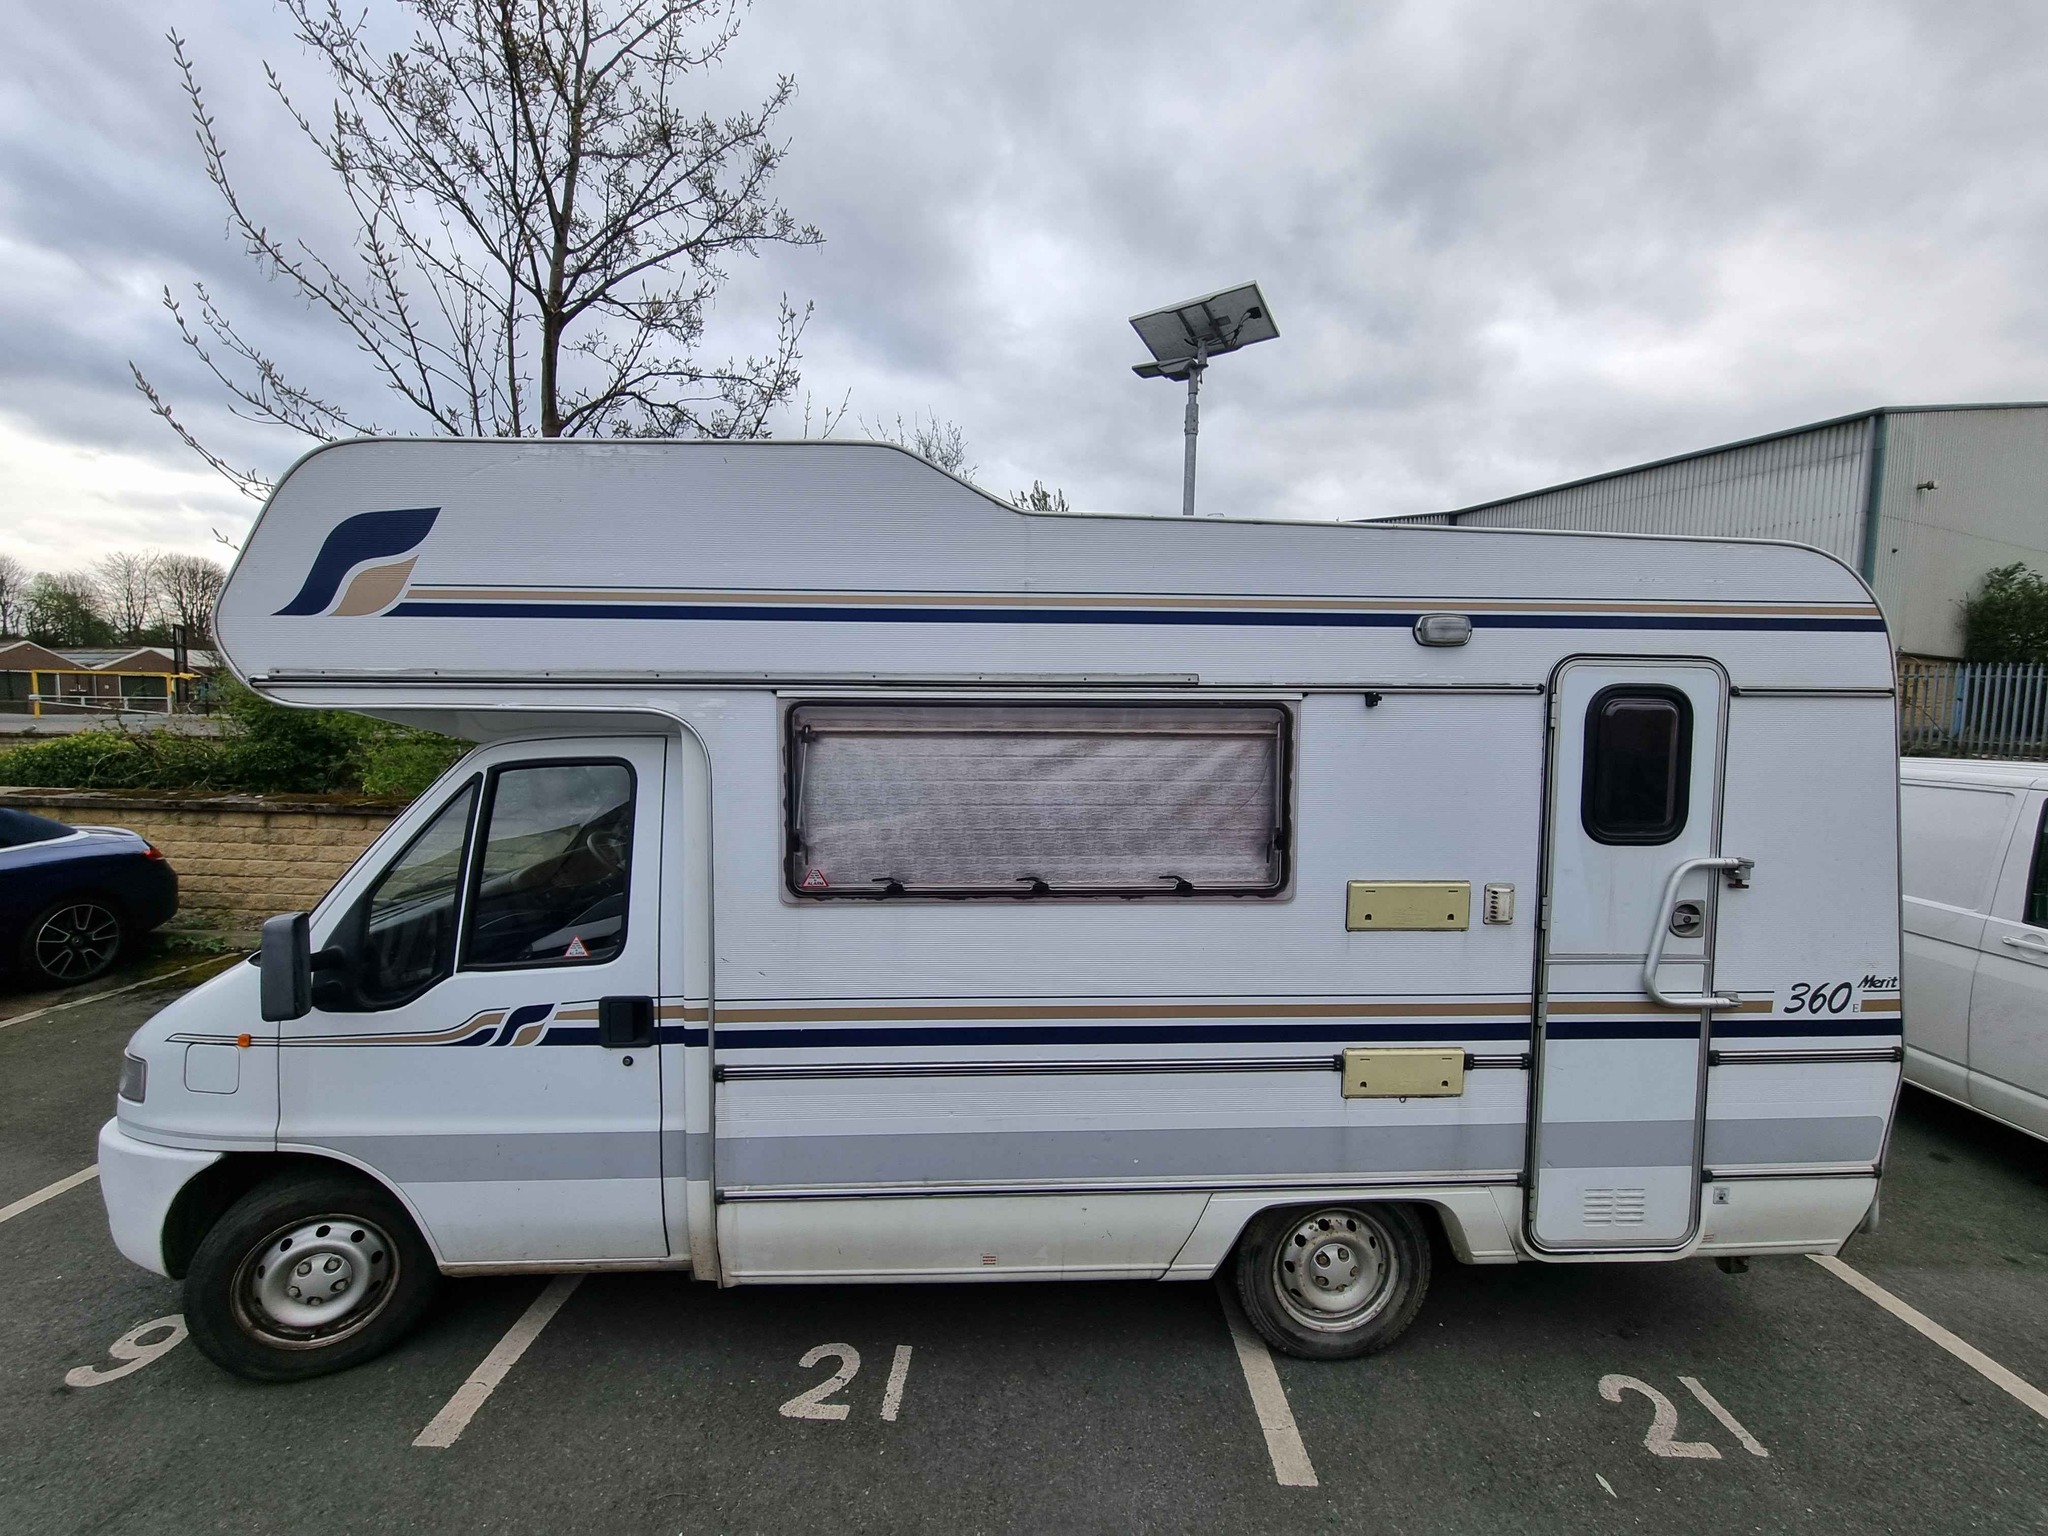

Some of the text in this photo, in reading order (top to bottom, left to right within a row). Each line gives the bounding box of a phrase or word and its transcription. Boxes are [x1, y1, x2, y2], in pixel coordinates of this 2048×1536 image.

[1783, 982, 1859, 1014] 360 E
[1857, 975, 1898, 989] Merit
[65, 1314, 189, 1387] 9
[779, 1343, 913, 1421] 21
[1598, 1374, 1768, 1458] 21
